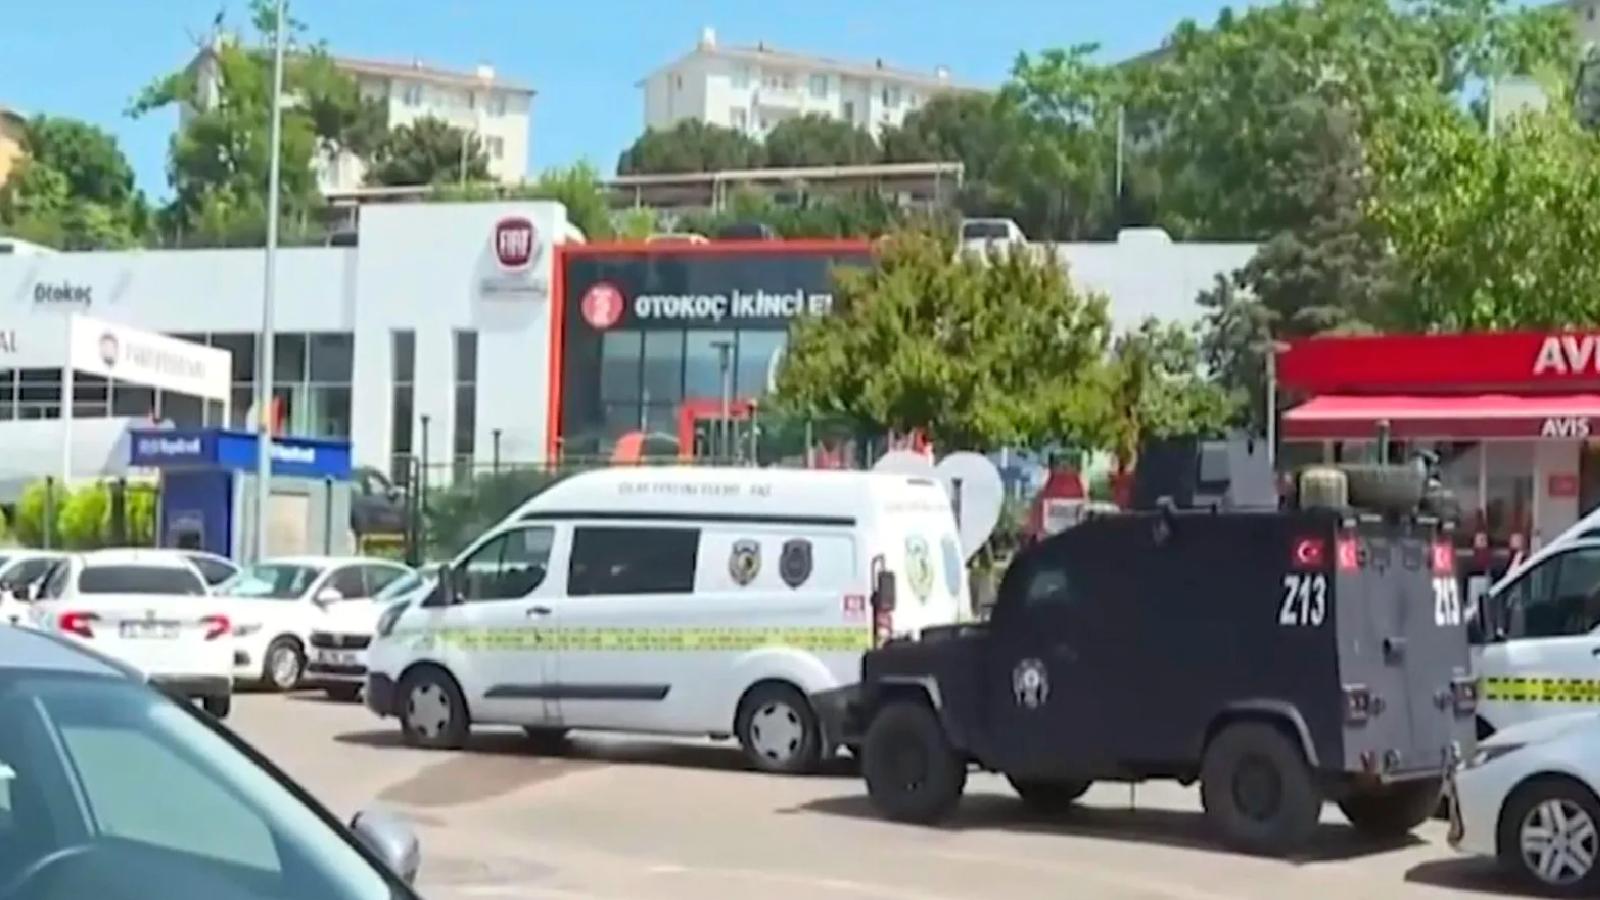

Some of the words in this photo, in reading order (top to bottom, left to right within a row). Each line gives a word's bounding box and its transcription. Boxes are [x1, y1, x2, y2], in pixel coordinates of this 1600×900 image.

[500, 229, 529, 258] FIAT
[34, 281, 92, 307] Otokoç
[634, 293, 728, 322] OTOKOÇ
[731, 288, 804, 318] İKİNCİ
[1541, 417, 1589, 438] AVIS
[1279, 575, 1326, 626] Z13
